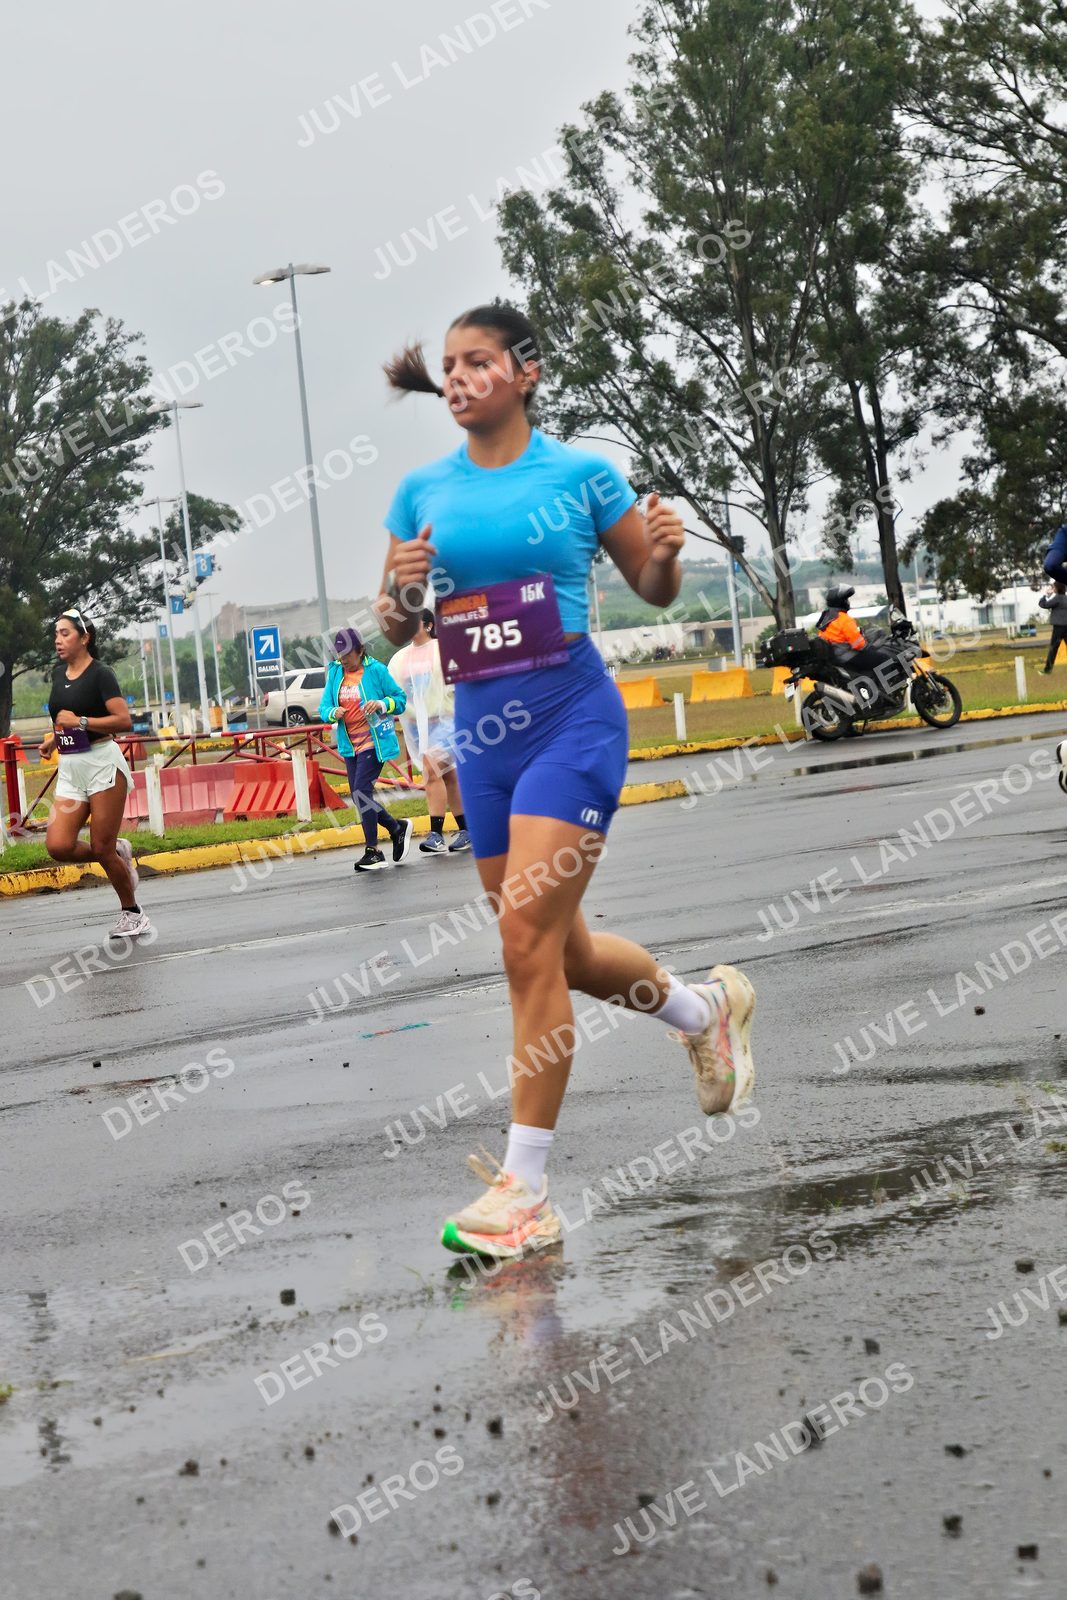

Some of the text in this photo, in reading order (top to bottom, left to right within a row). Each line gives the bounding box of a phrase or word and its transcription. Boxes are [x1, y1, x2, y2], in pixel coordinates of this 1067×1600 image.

[200, 558, 208, 572] 8
[520, 582, 546, 603] 15K
[174, 601, 180, 611] 7
[465, 619, 523, 653] 785
[257, 664, 279, 673] SALIDA
[59, 736, 75, 746] 782
